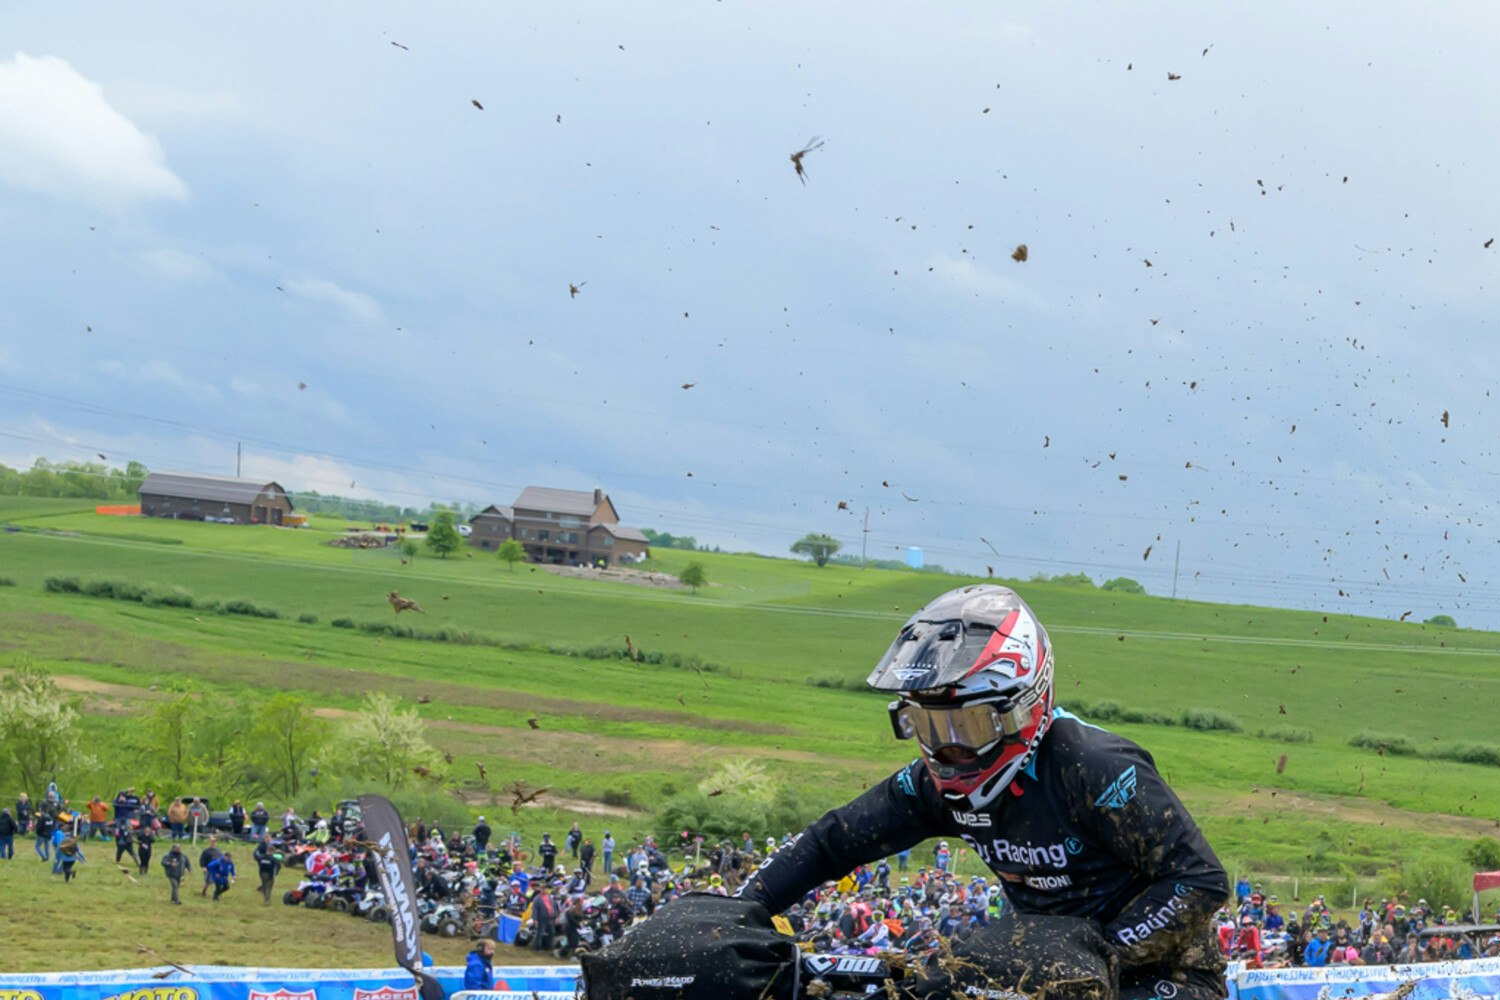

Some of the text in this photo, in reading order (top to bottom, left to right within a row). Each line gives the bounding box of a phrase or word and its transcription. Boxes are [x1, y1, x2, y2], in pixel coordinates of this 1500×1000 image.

[952, 811, 992, 827] WPS
[993, 839, 1068, 868] Racing
[836, 959, 881, 974] ODI
